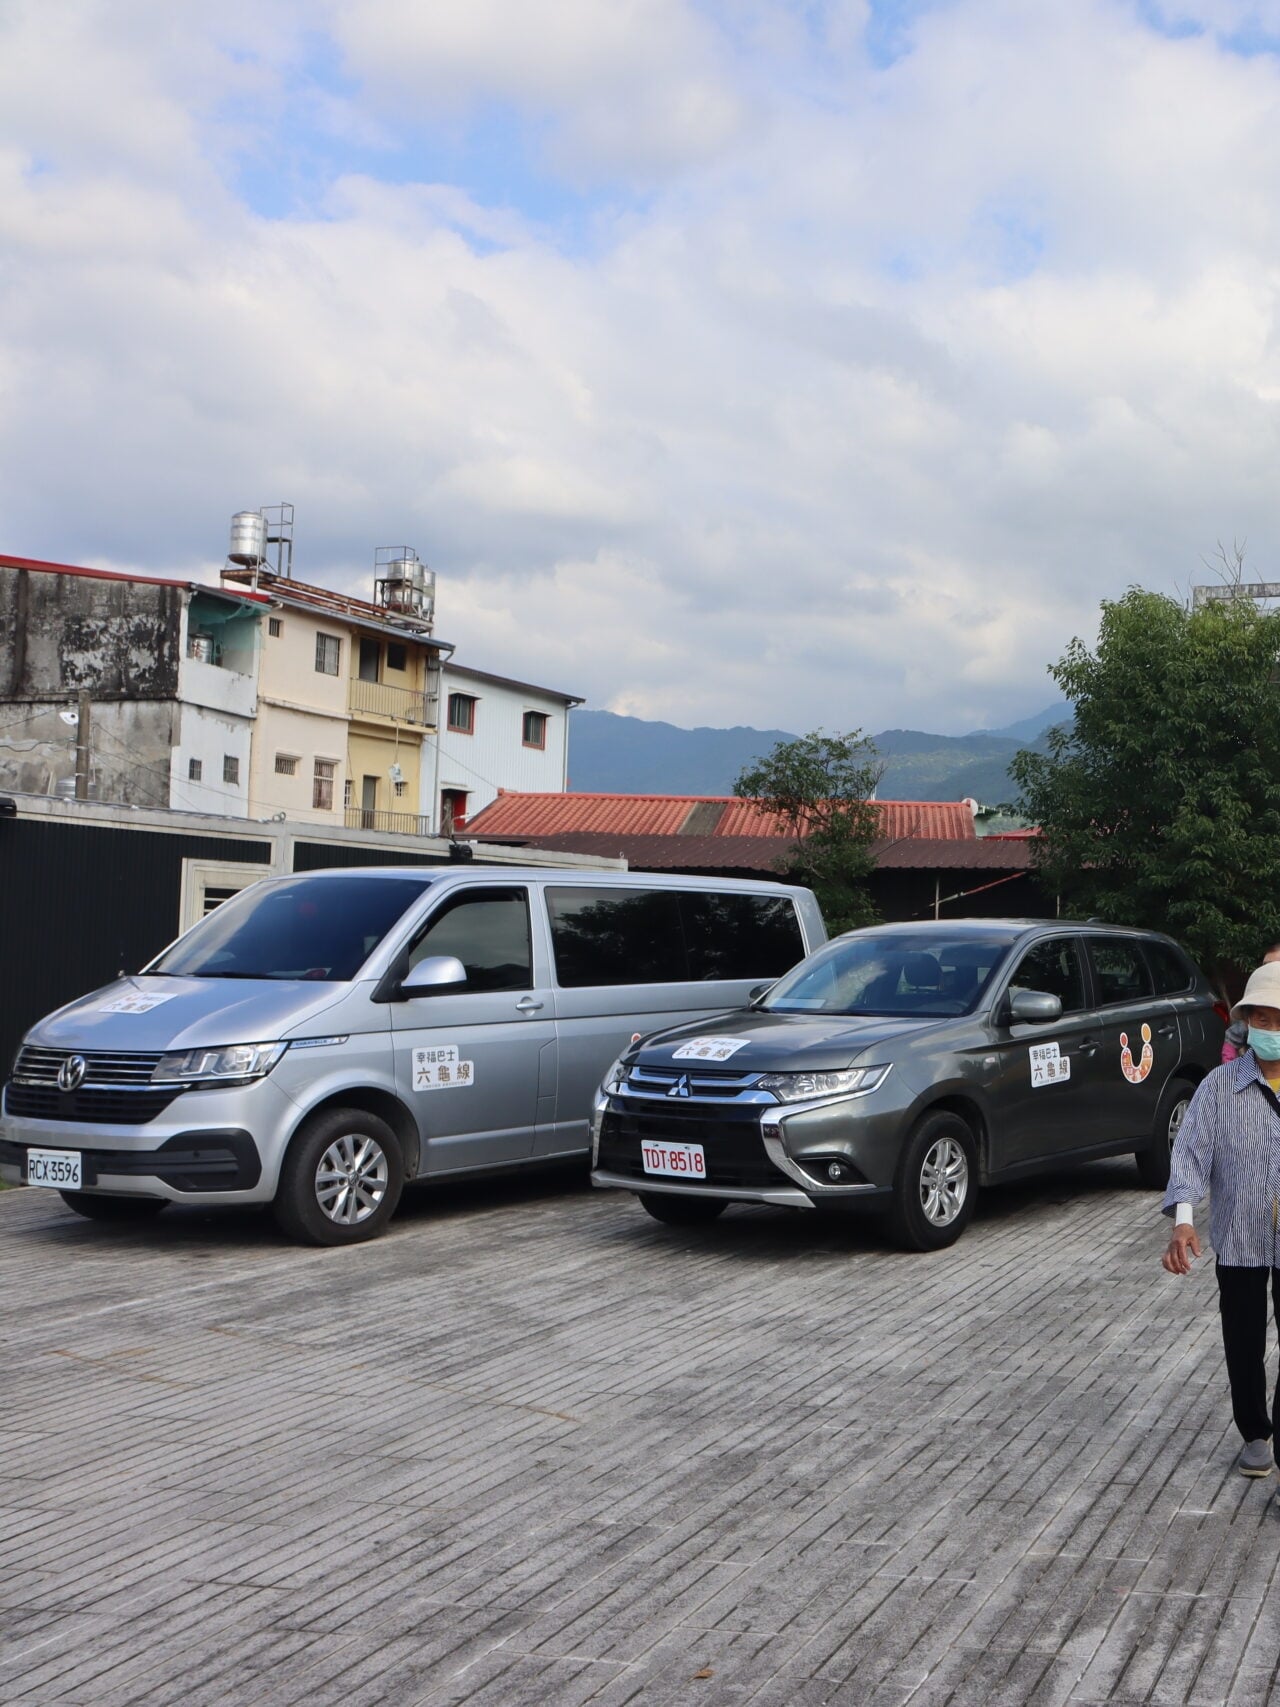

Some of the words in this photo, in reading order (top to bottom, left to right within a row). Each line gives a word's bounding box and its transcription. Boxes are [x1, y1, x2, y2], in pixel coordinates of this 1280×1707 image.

[416, 1049, 456, 1064] 幸福巴士
[417, 1063, 470, 1084] 六龜線
